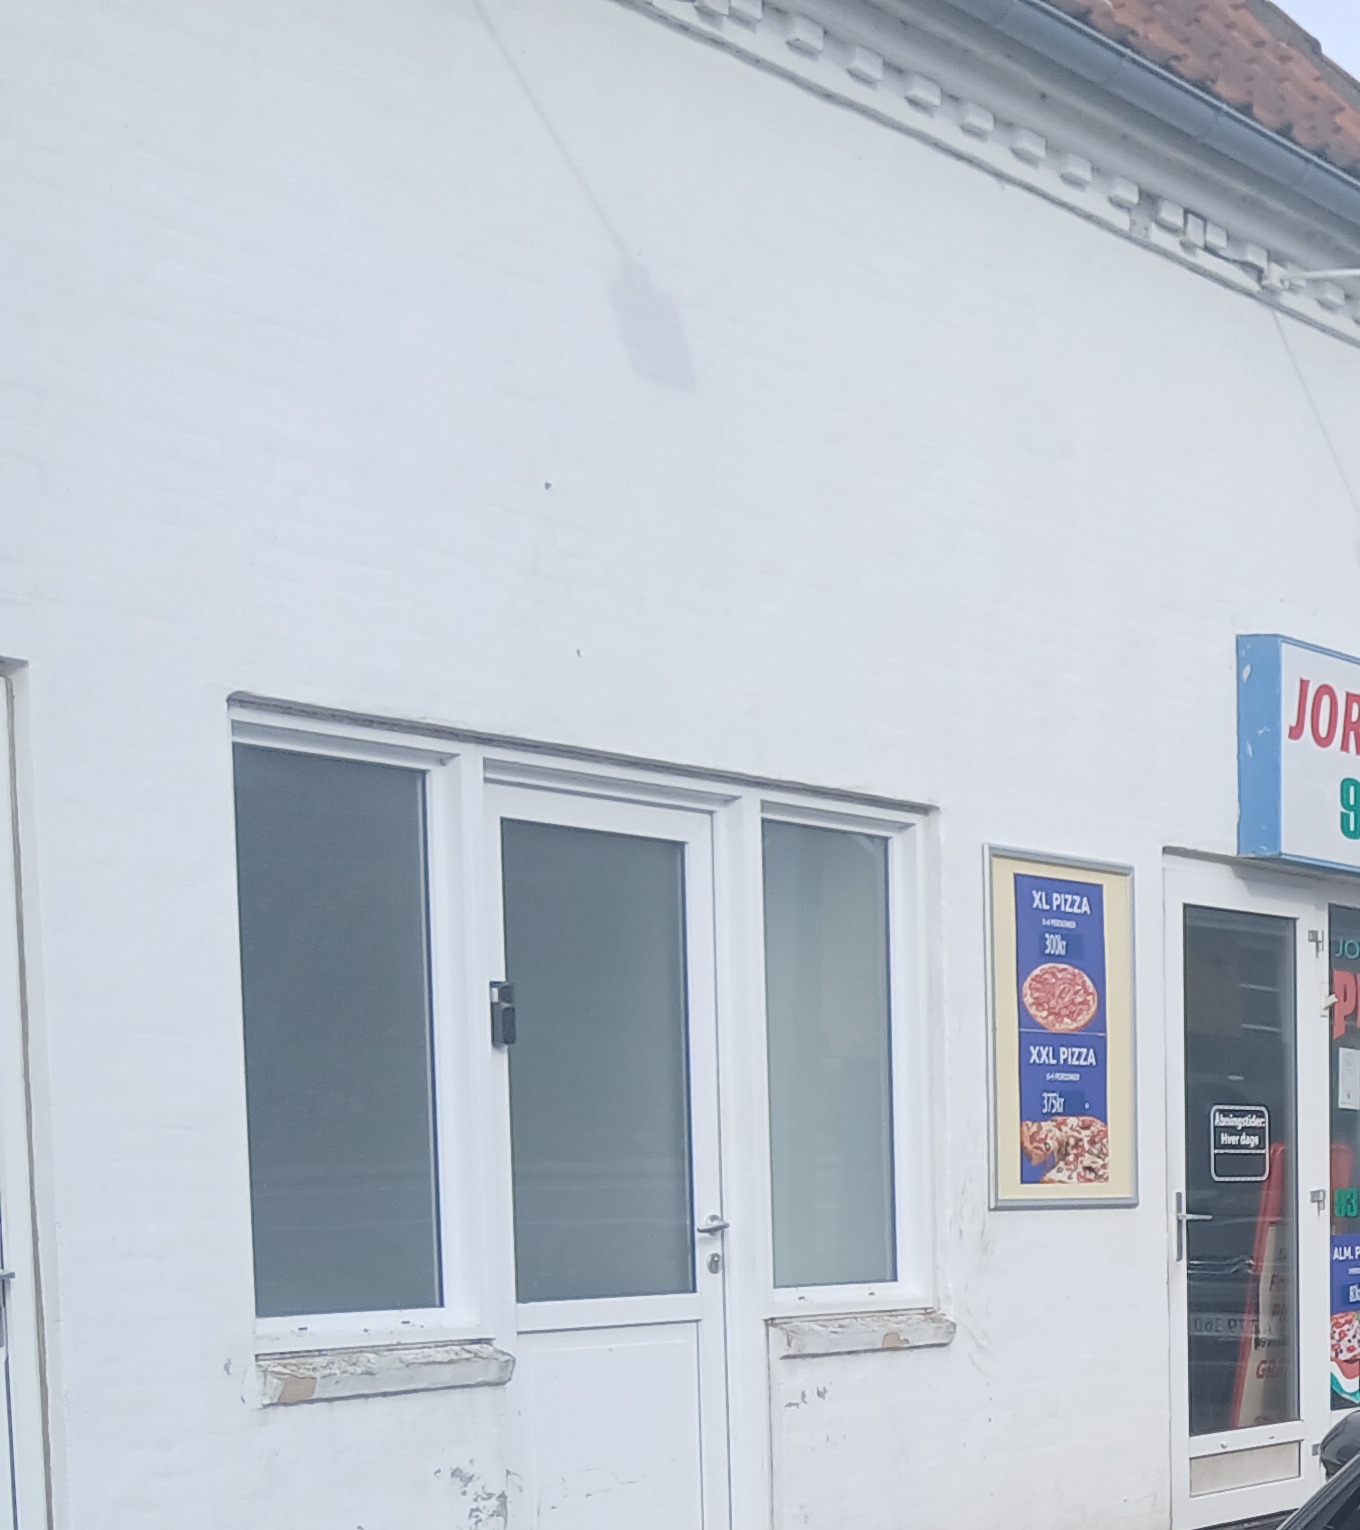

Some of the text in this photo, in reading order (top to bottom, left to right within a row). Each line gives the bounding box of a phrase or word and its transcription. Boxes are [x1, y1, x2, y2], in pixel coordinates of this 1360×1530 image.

[1032, 890, 1091, 915] XL PIZZA
[1030, 1045, 1097, 1067] XXL PIZZA
